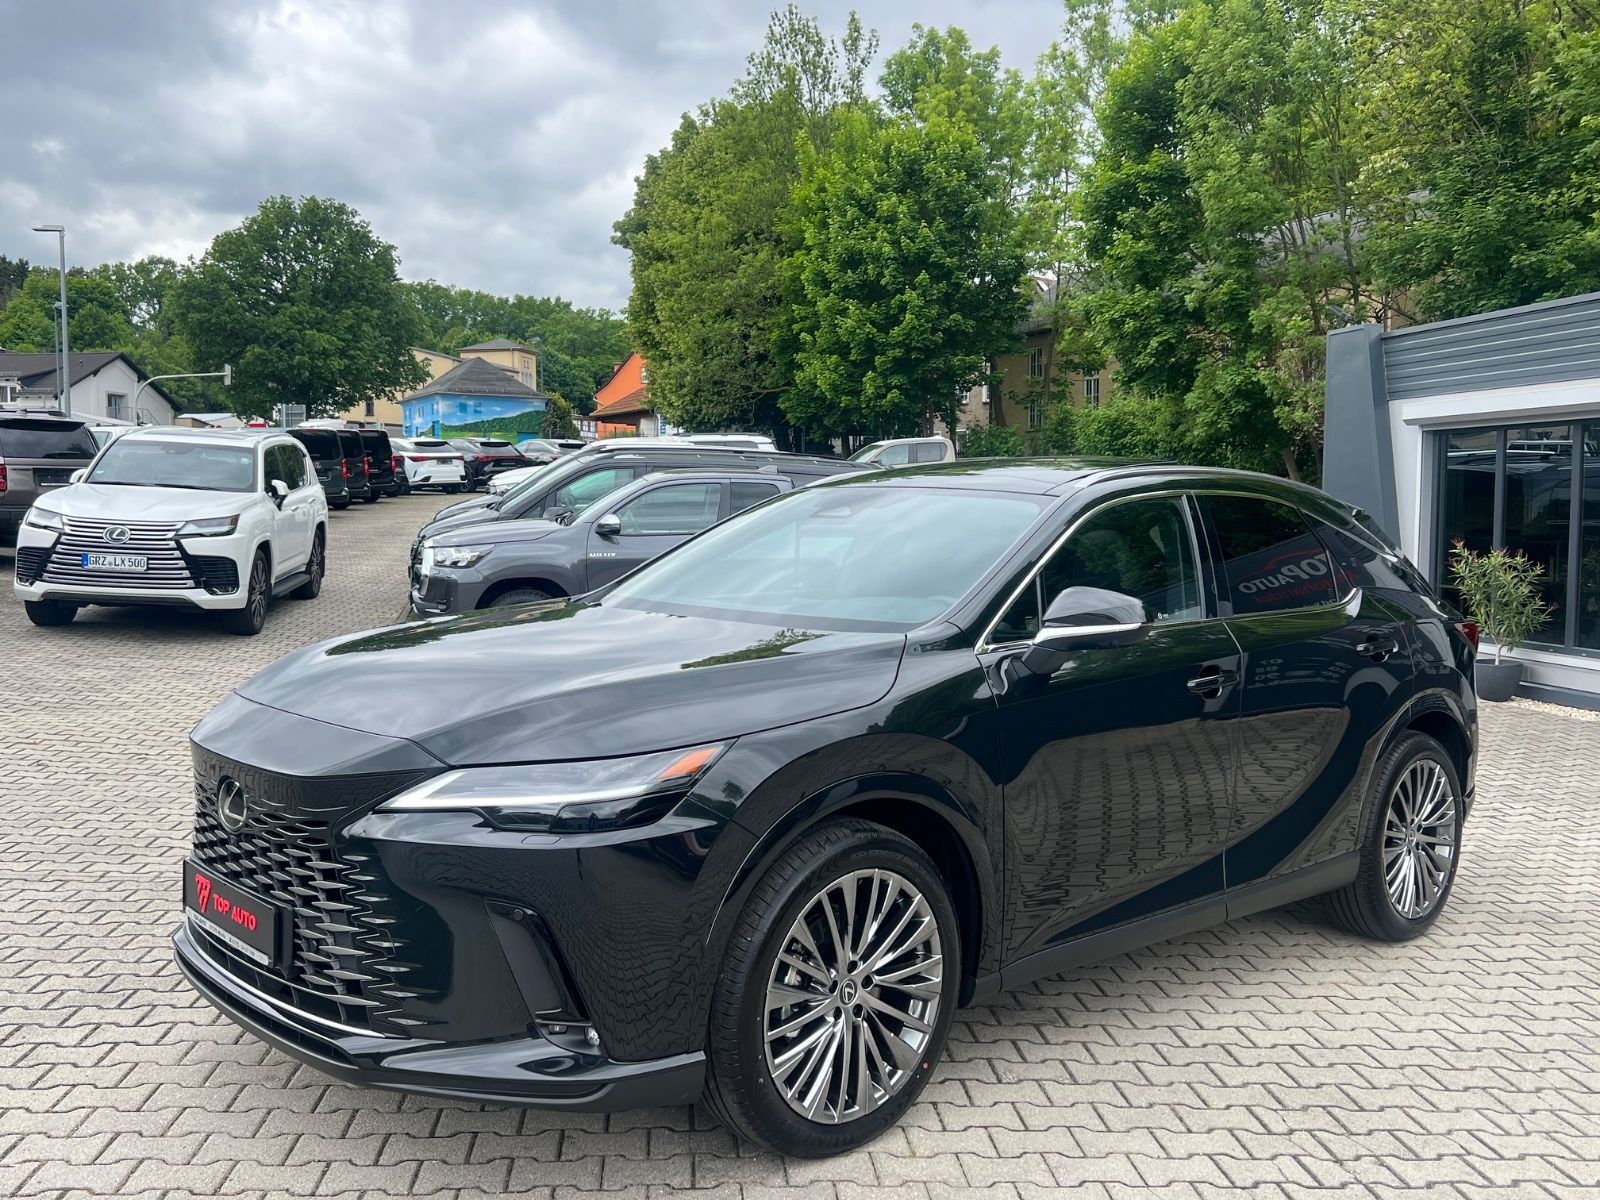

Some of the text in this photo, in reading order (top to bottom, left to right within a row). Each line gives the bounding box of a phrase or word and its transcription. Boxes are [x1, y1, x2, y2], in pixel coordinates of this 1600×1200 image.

[89, 555, 146, 568] GRZ LX 500
[213, 893, 257, 931] TOP AUTO
